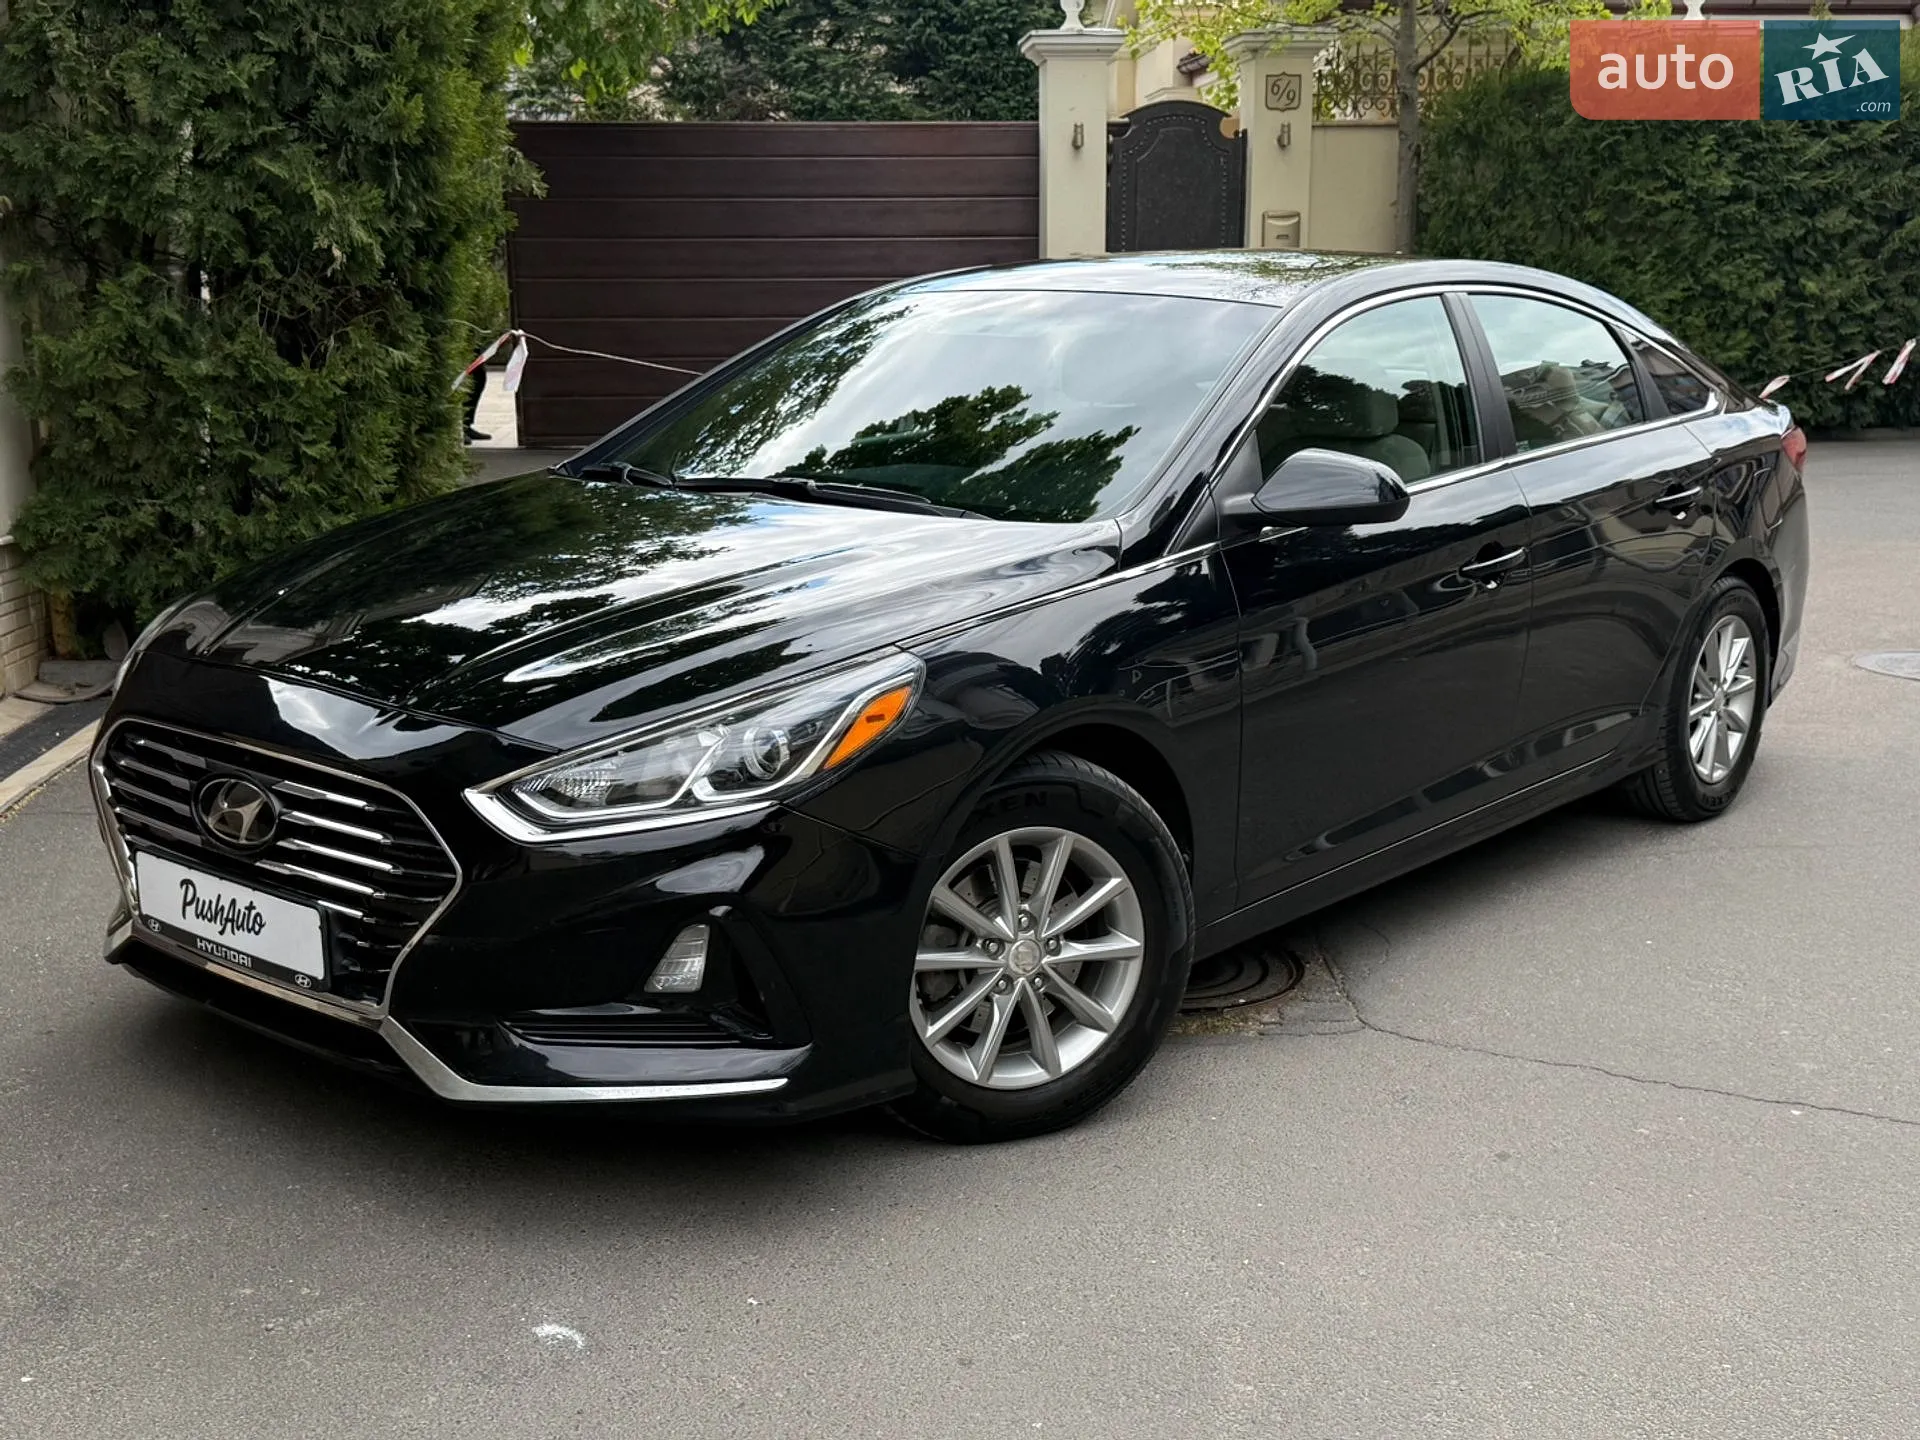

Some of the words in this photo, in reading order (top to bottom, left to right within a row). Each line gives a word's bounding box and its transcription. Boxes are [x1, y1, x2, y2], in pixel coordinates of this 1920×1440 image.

[1271, 78, 1296, 107] 6/9
[180, 878, 266, 936] PushAuto
[196, 938, 252, 968] HYUNDAI
